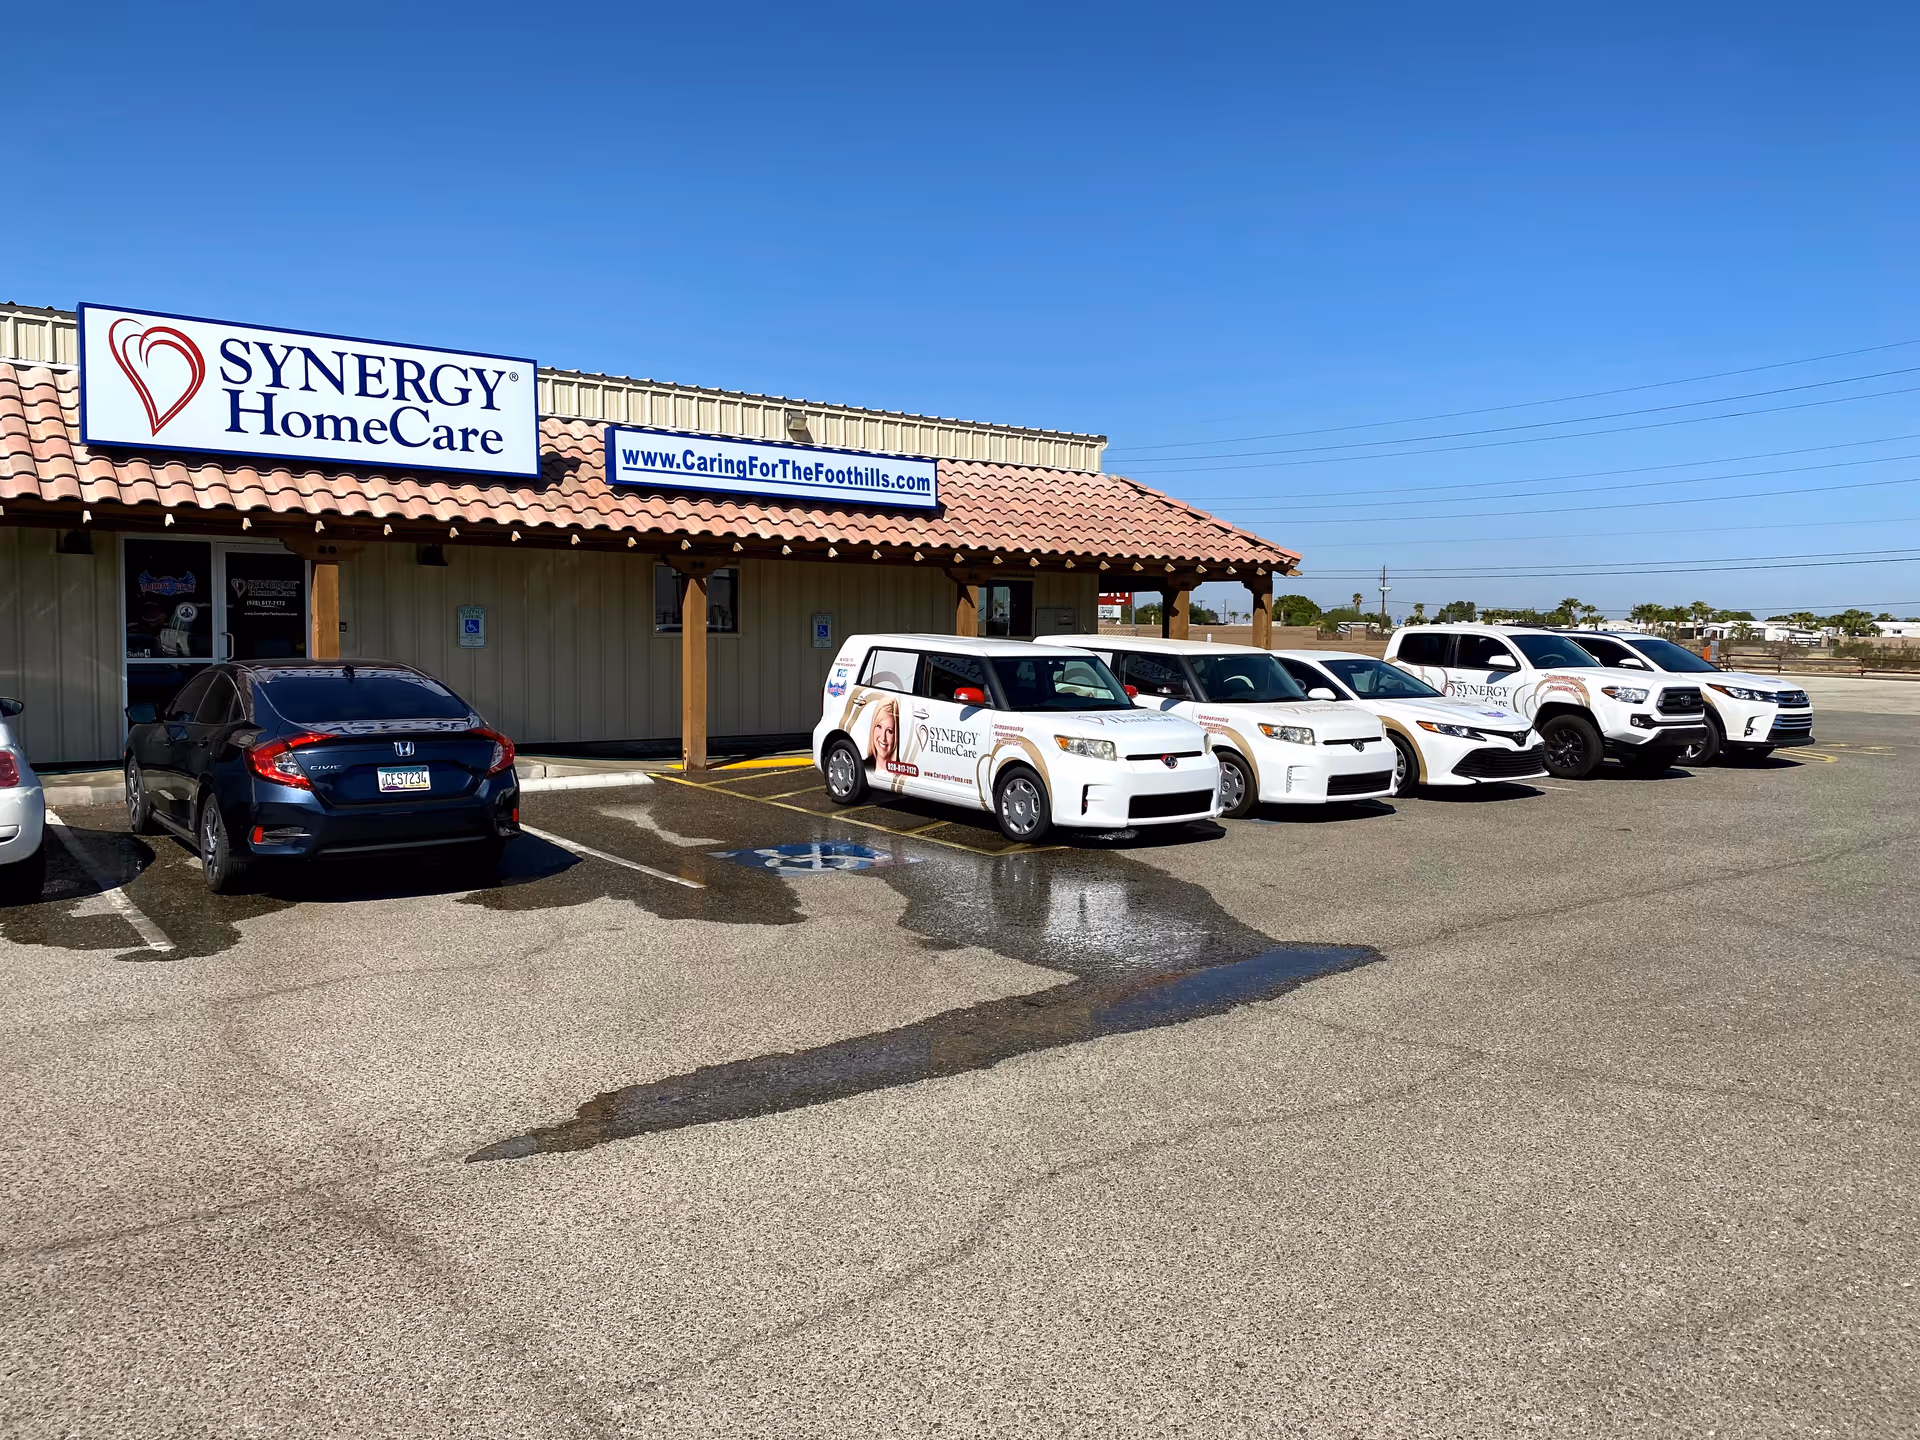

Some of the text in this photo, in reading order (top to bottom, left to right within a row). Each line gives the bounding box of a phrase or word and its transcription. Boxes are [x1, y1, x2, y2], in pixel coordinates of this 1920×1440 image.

[222, 387, 504, 455] HomeCare
[622, 448, 931, 492] www.CaringForTheFoothills.com
[1456, 684, 1509, 697] SYNERGY
[930, 726, 978, 745] SYNERGY
[930, 740, 977, 759] HomeCare
[385, 771, 427, 786] CES7234
